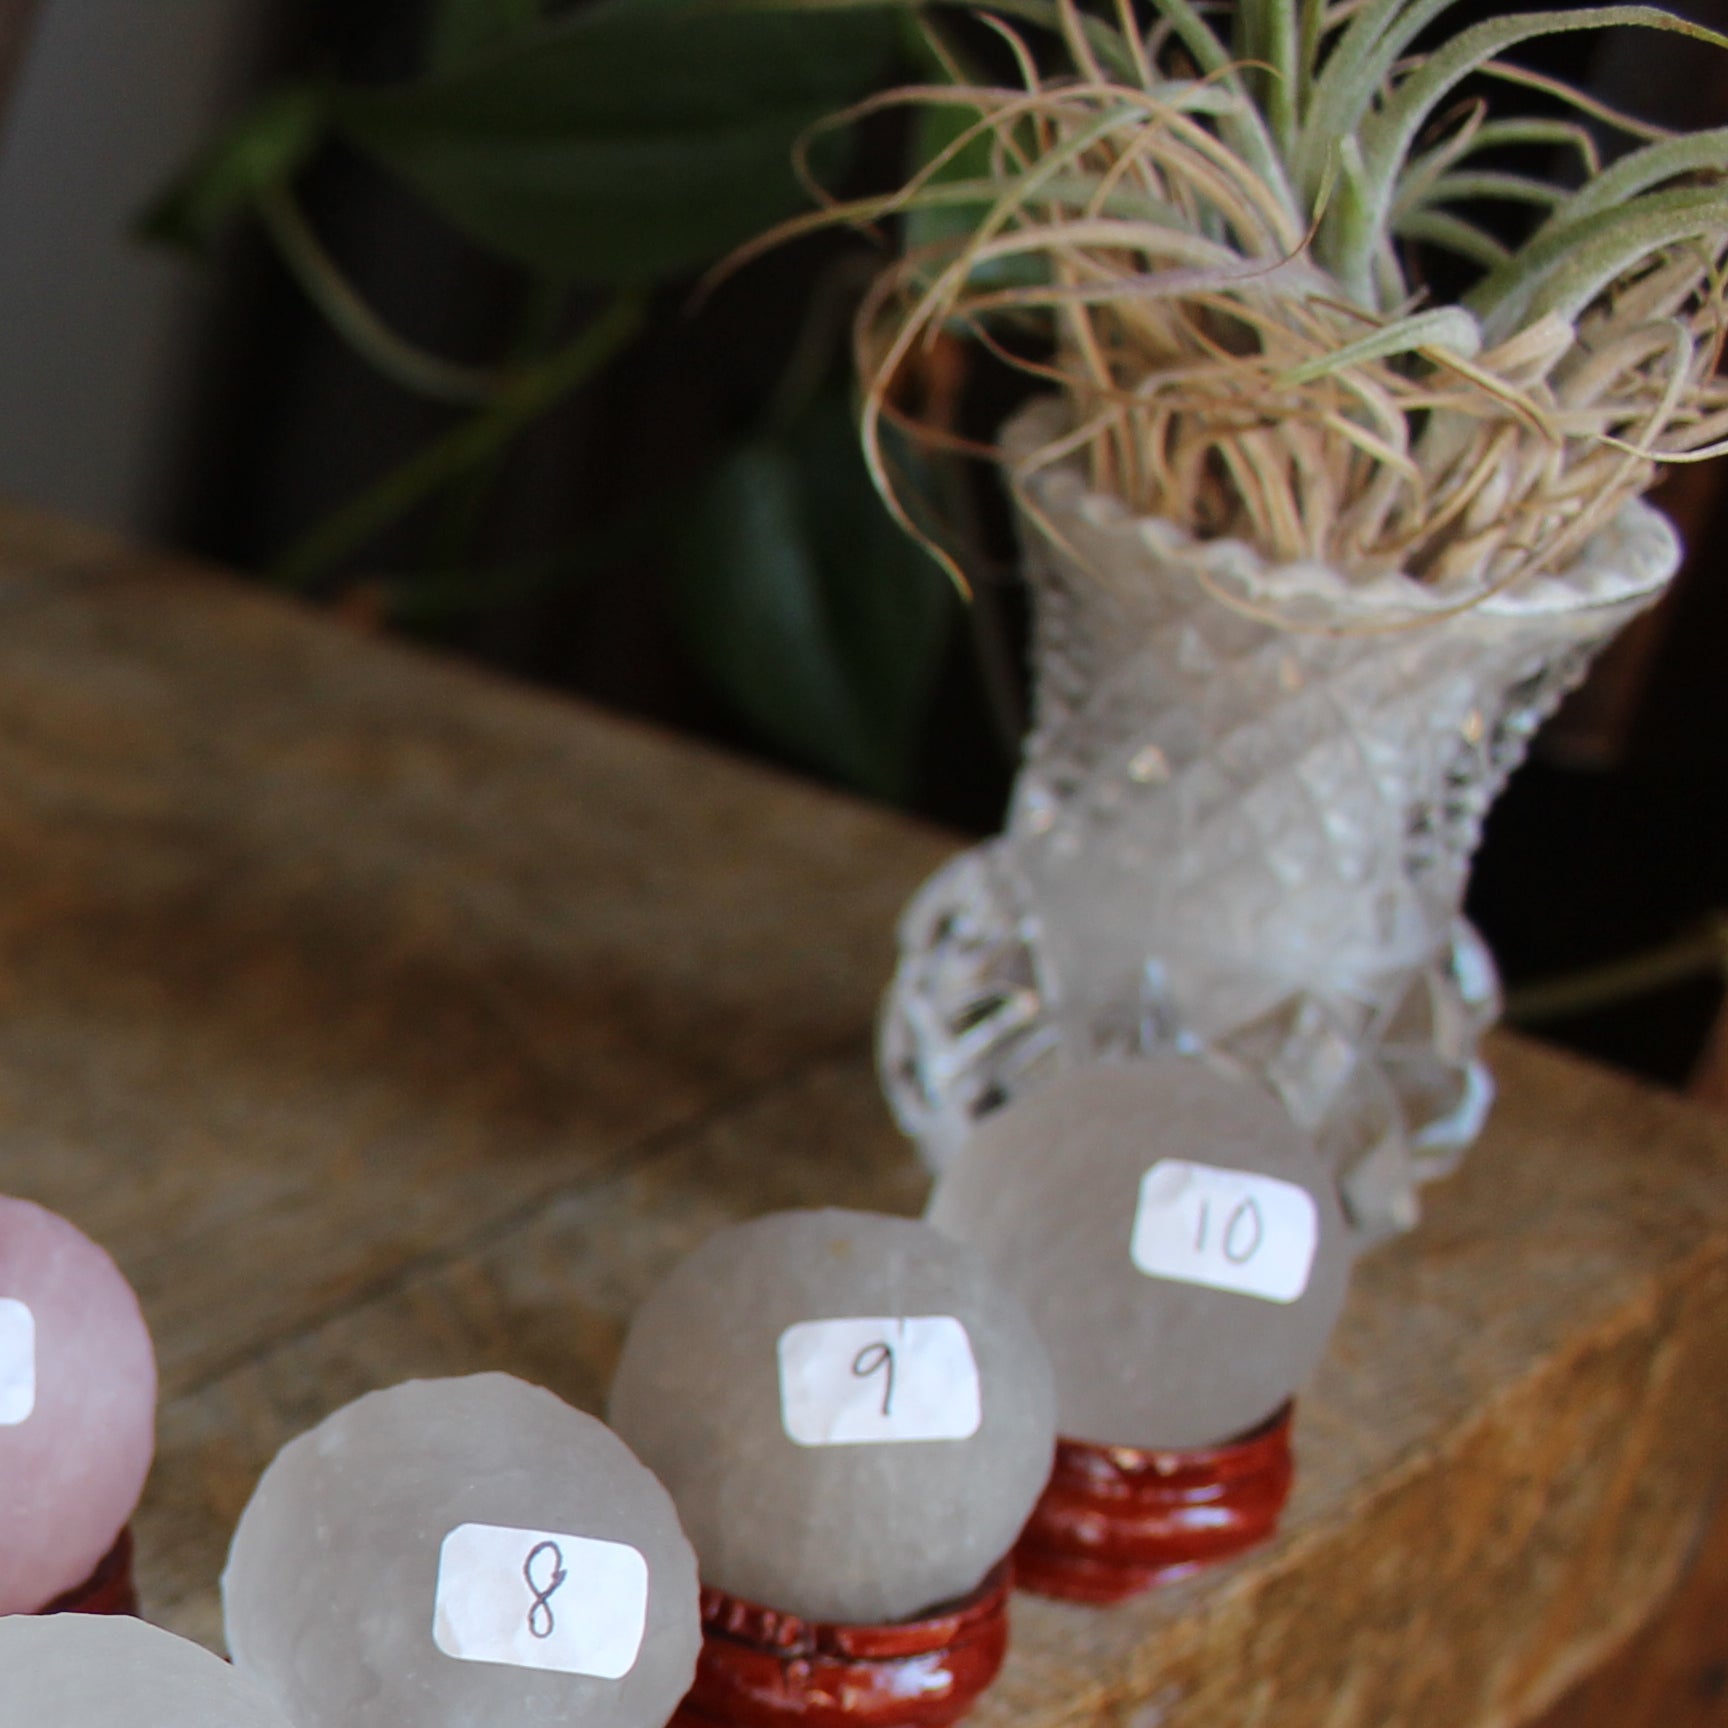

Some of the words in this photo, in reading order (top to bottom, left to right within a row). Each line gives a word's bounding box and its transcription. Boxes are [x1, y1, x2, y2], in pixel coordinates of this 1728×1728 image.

[1194, 1195, 1264, 1266] 10
[851, 1341, 896, 1418] 9
[523, 1540, 567, 1640] 8
